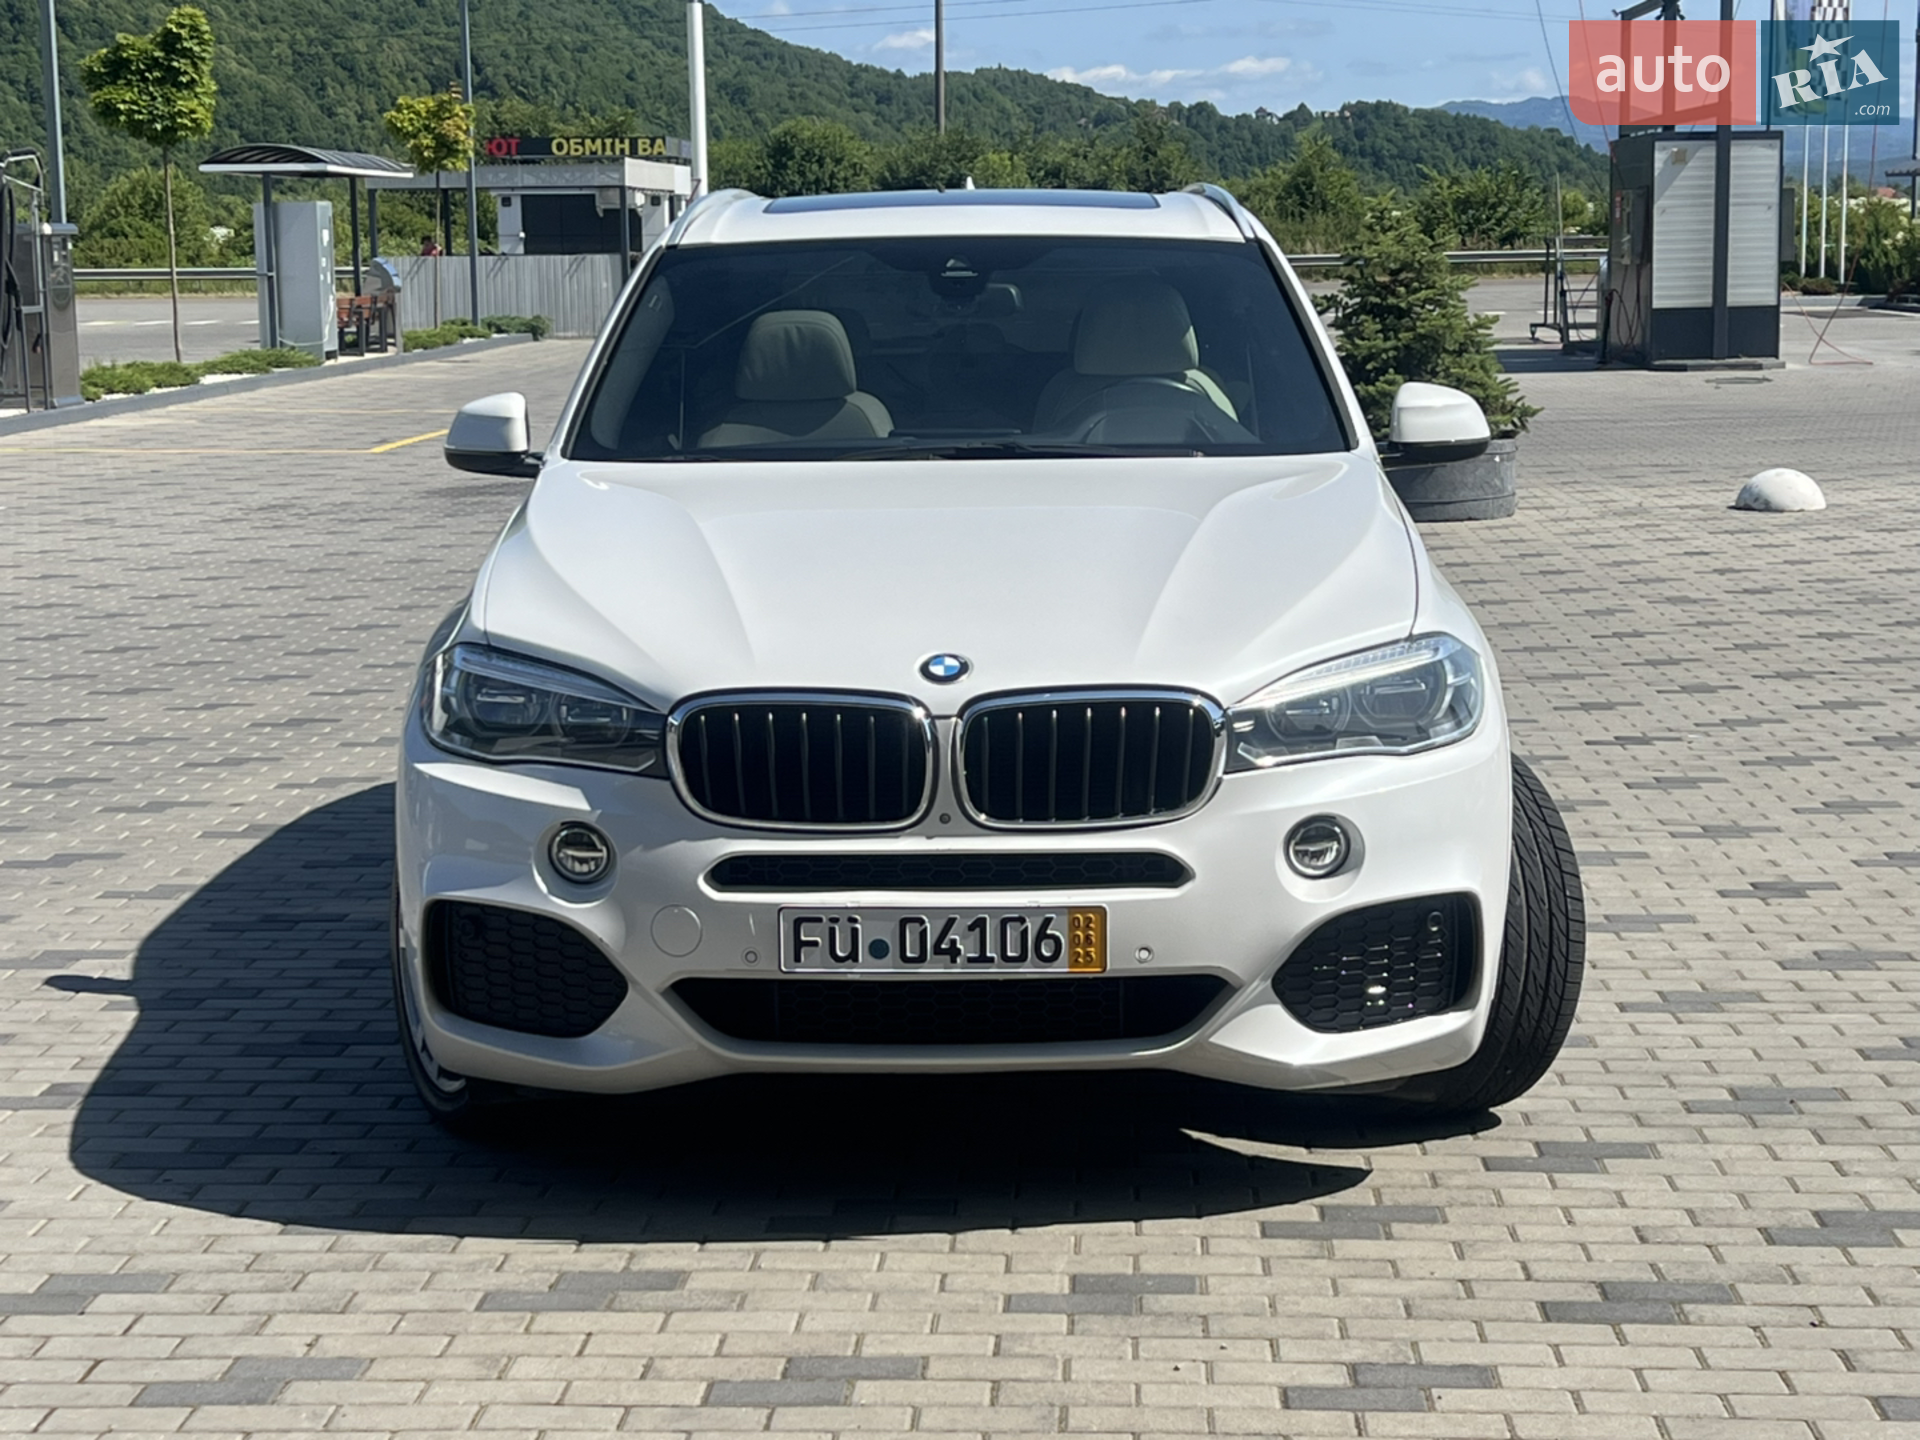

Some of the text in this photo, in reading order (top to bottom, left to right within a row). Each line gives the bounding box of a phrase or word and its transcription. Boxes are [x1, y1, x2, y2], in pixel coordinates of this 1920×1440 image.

[551, 138, 630, 156] ОБМІН
[637, 138, 667, 156] ВА
[1072, 913, 1096, 929] 02
[792, 914, 1064, 964] FÜ 04106
[1072, 930, 1096, 947] 06
[1072, 947, 1097, 964] 25
